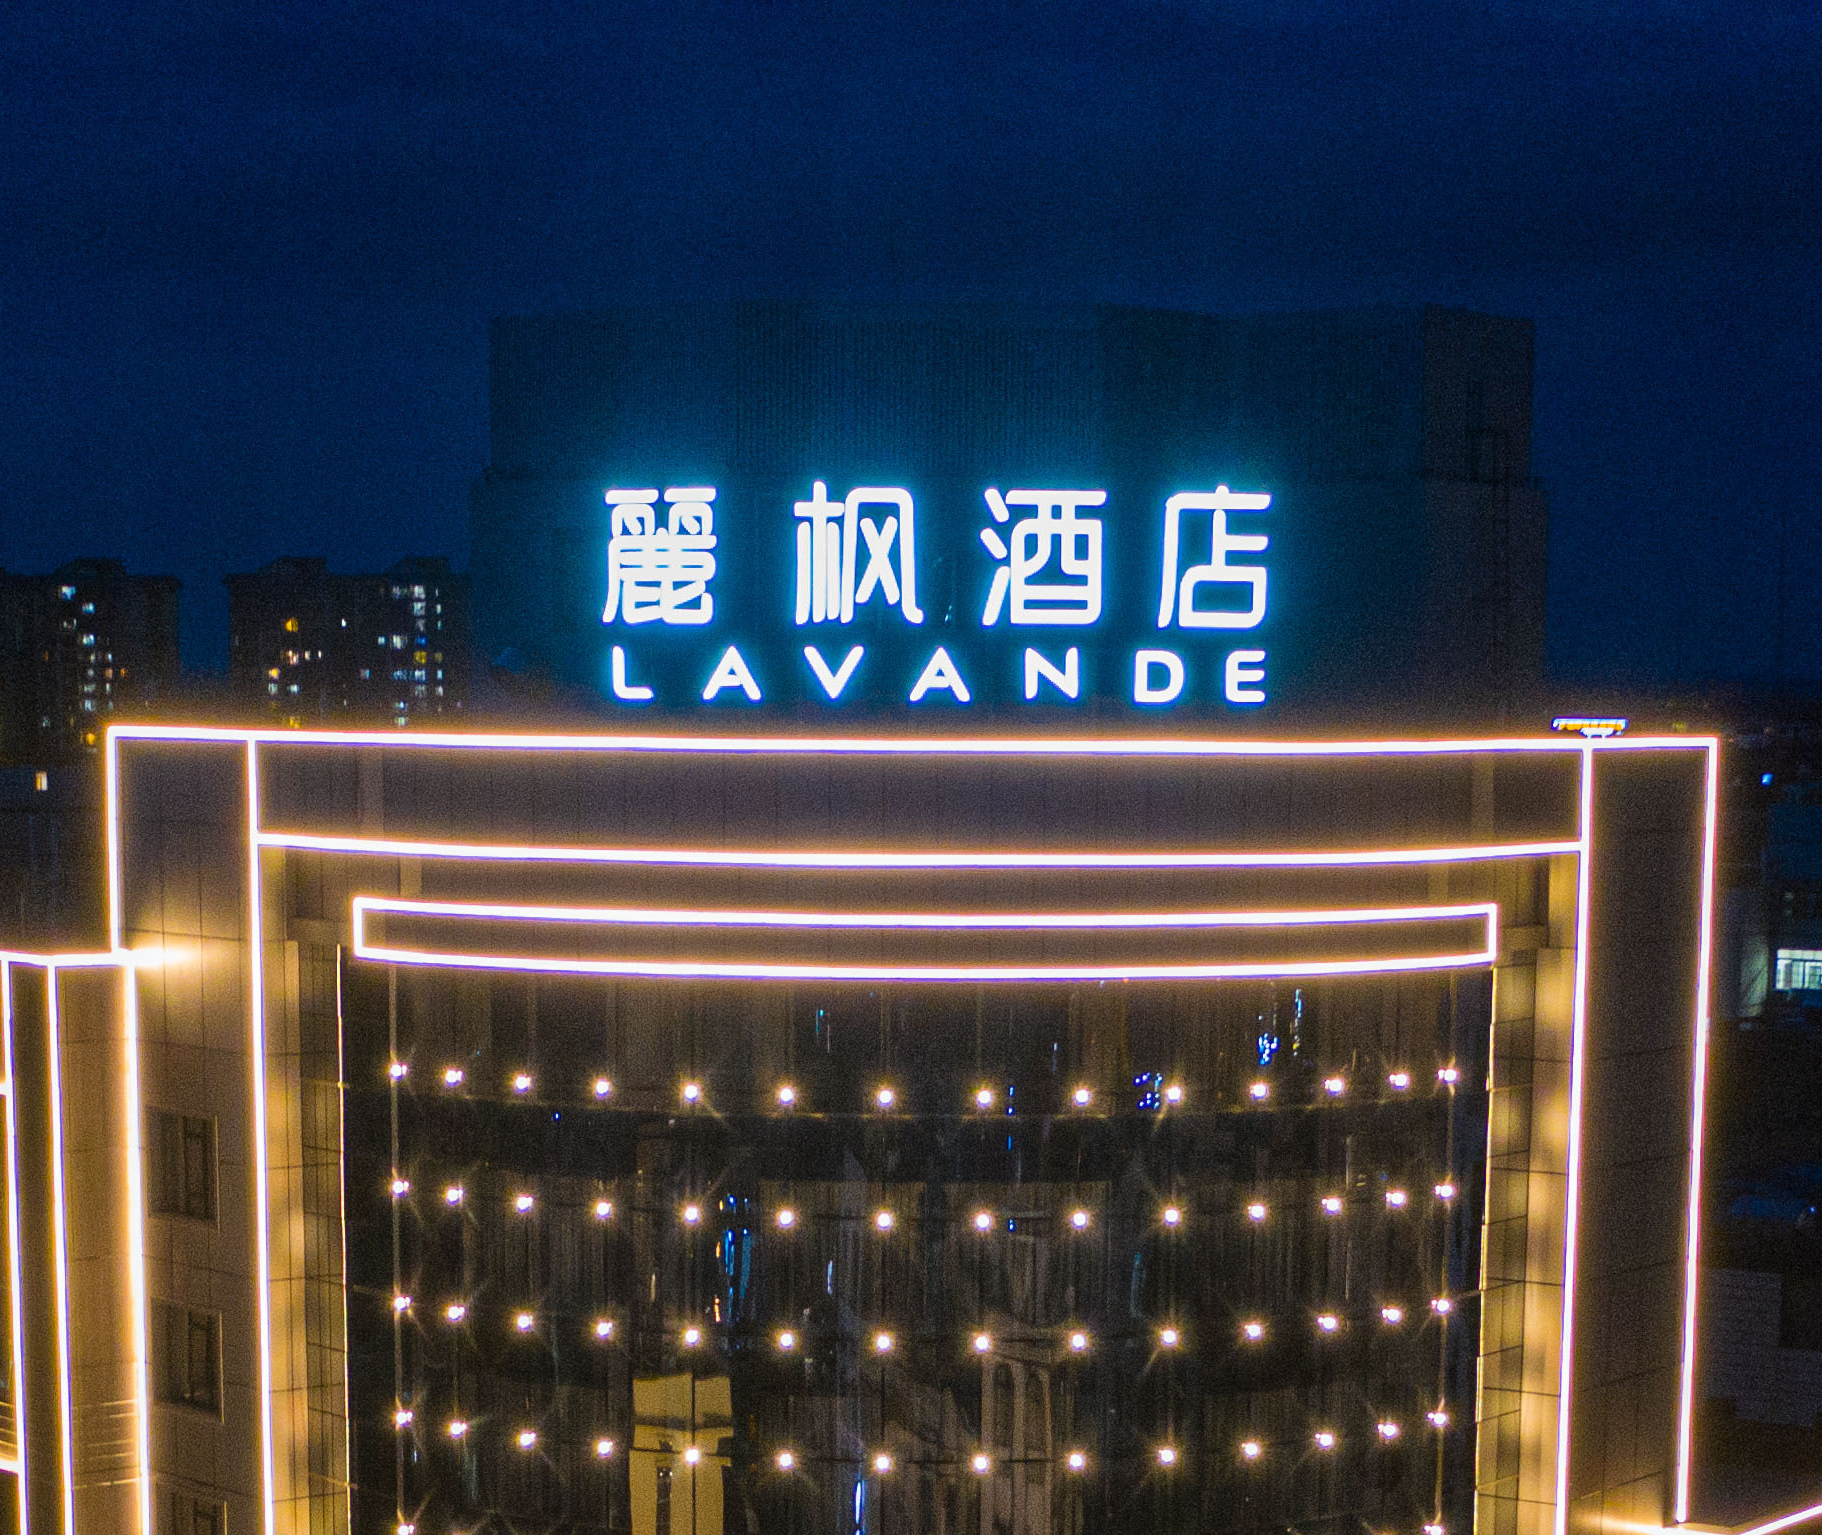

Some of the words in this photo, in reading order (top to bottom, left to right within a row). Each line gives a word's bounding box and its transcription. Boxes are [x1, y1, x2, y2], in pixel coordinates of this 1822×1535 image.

[602, 480, 1272, 629] 麗枫酒店
[611, 645, 1267, 704] LAVANDE
